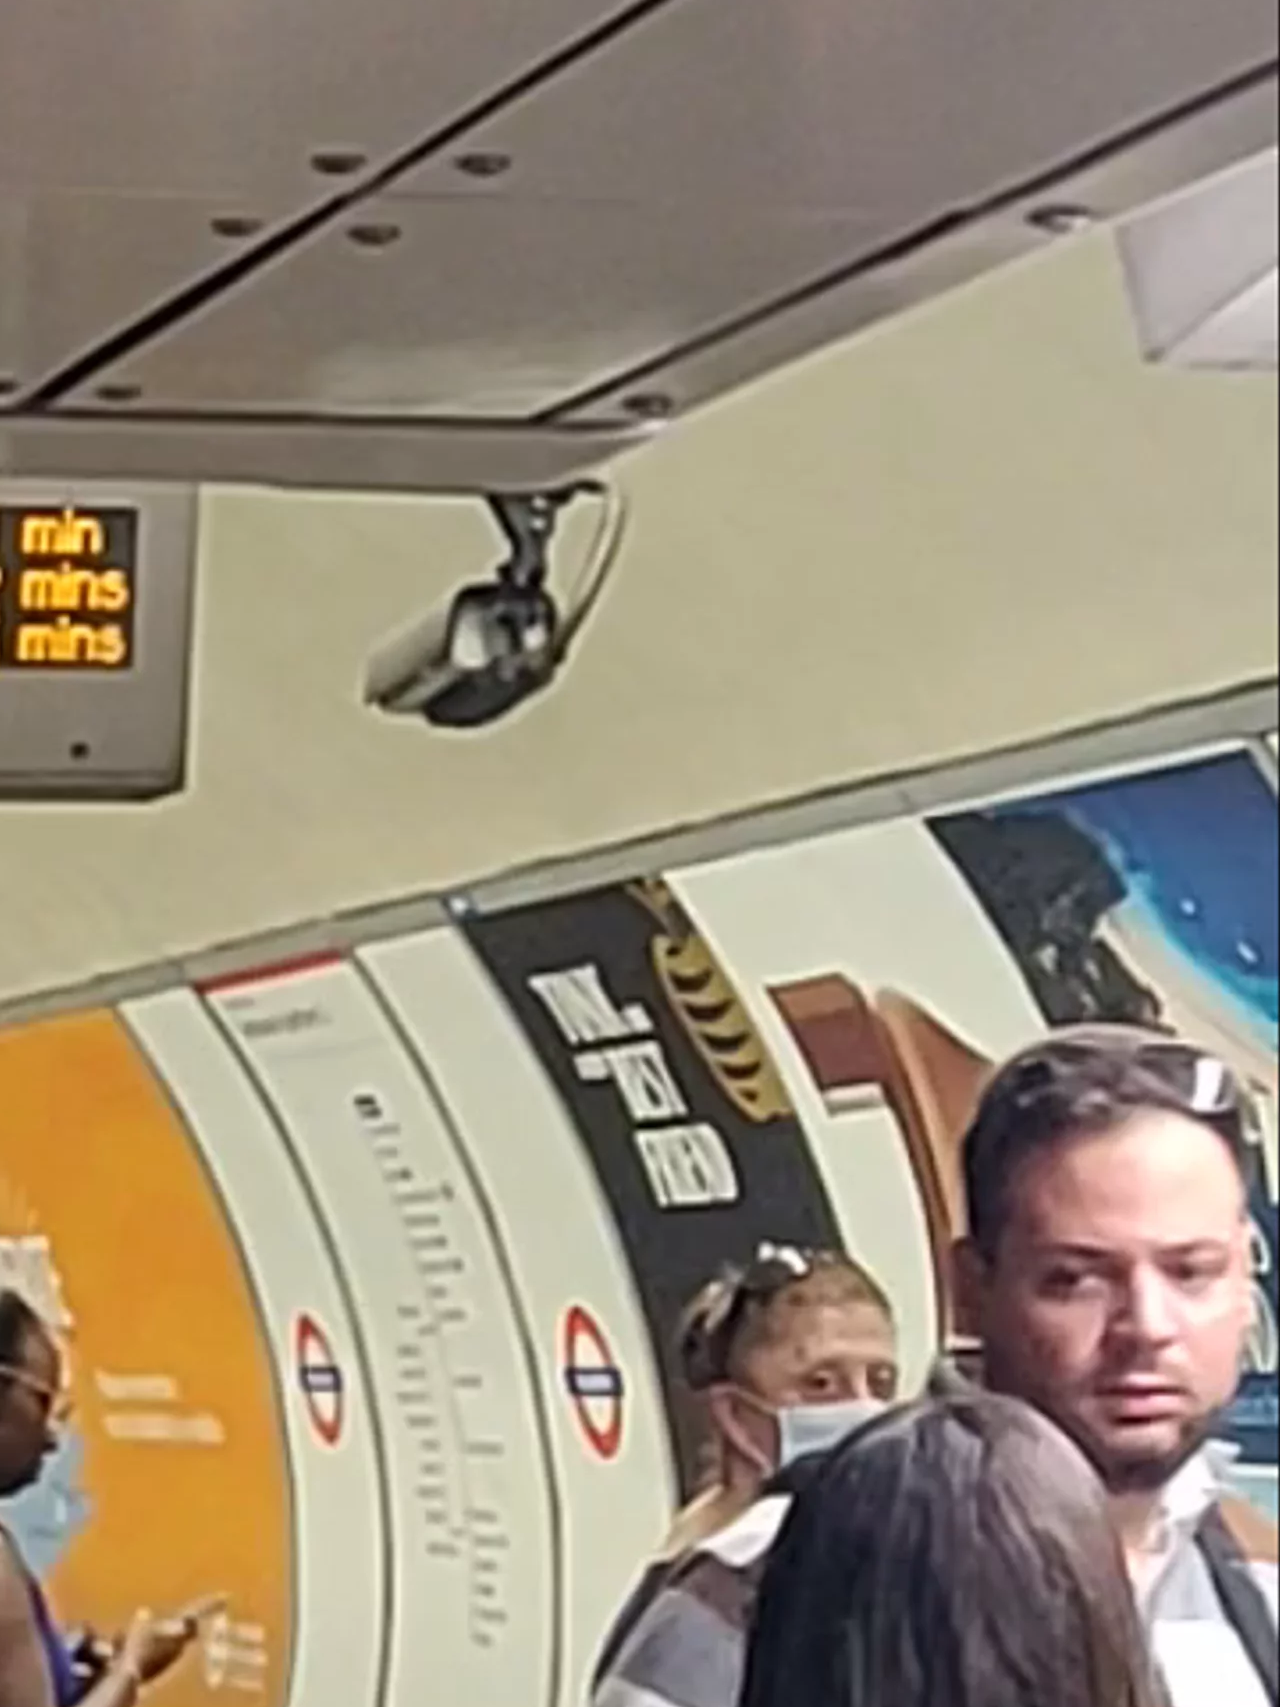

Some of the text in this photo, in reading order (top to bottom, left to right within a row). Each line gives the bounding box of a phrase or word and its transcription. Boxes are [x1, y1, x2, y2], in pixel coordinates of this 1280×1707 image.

[21, 507, 104, 556] min
[19, 560, 130, 613] mins
[15, 615, 126, 665] mins
